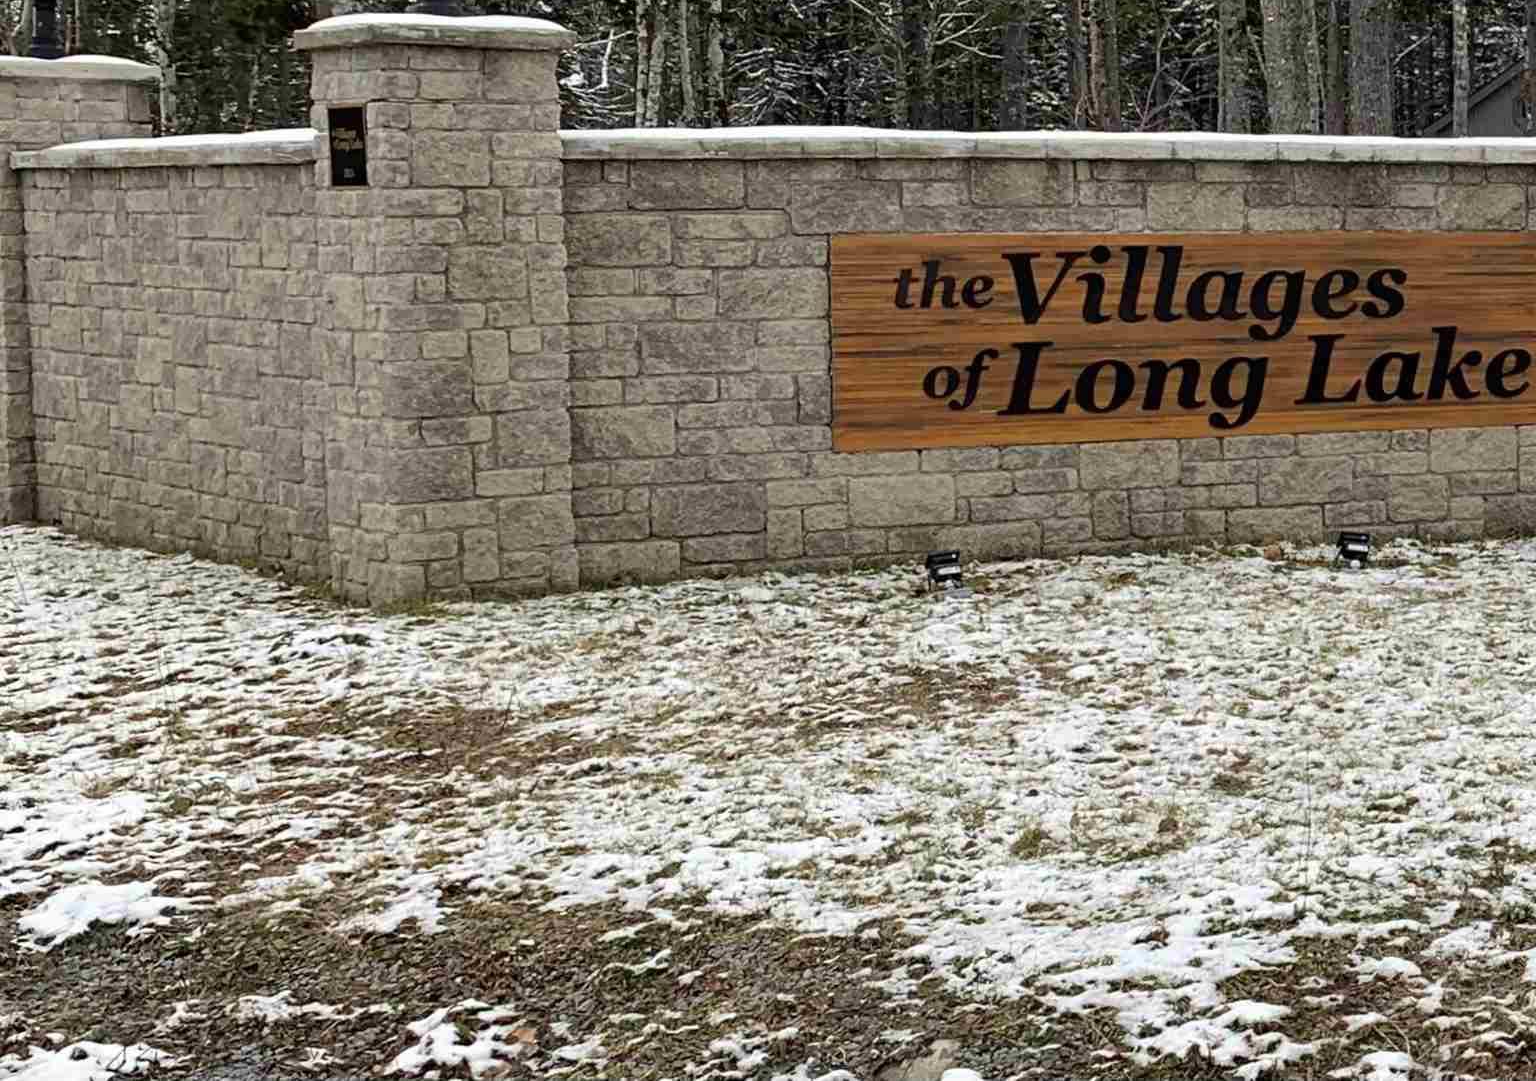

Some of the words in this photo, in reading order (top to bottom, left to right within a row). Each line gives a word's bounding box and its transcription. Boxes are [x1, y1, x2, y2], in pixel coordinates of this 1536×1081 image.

[893, 259, 994, 309] the
[1001, 245, 1408, 341] Villages
[923, 348, 999, 411] of
[998, 342, 1269, 429] Long
[1294, 326, 1532, 405] Lake
